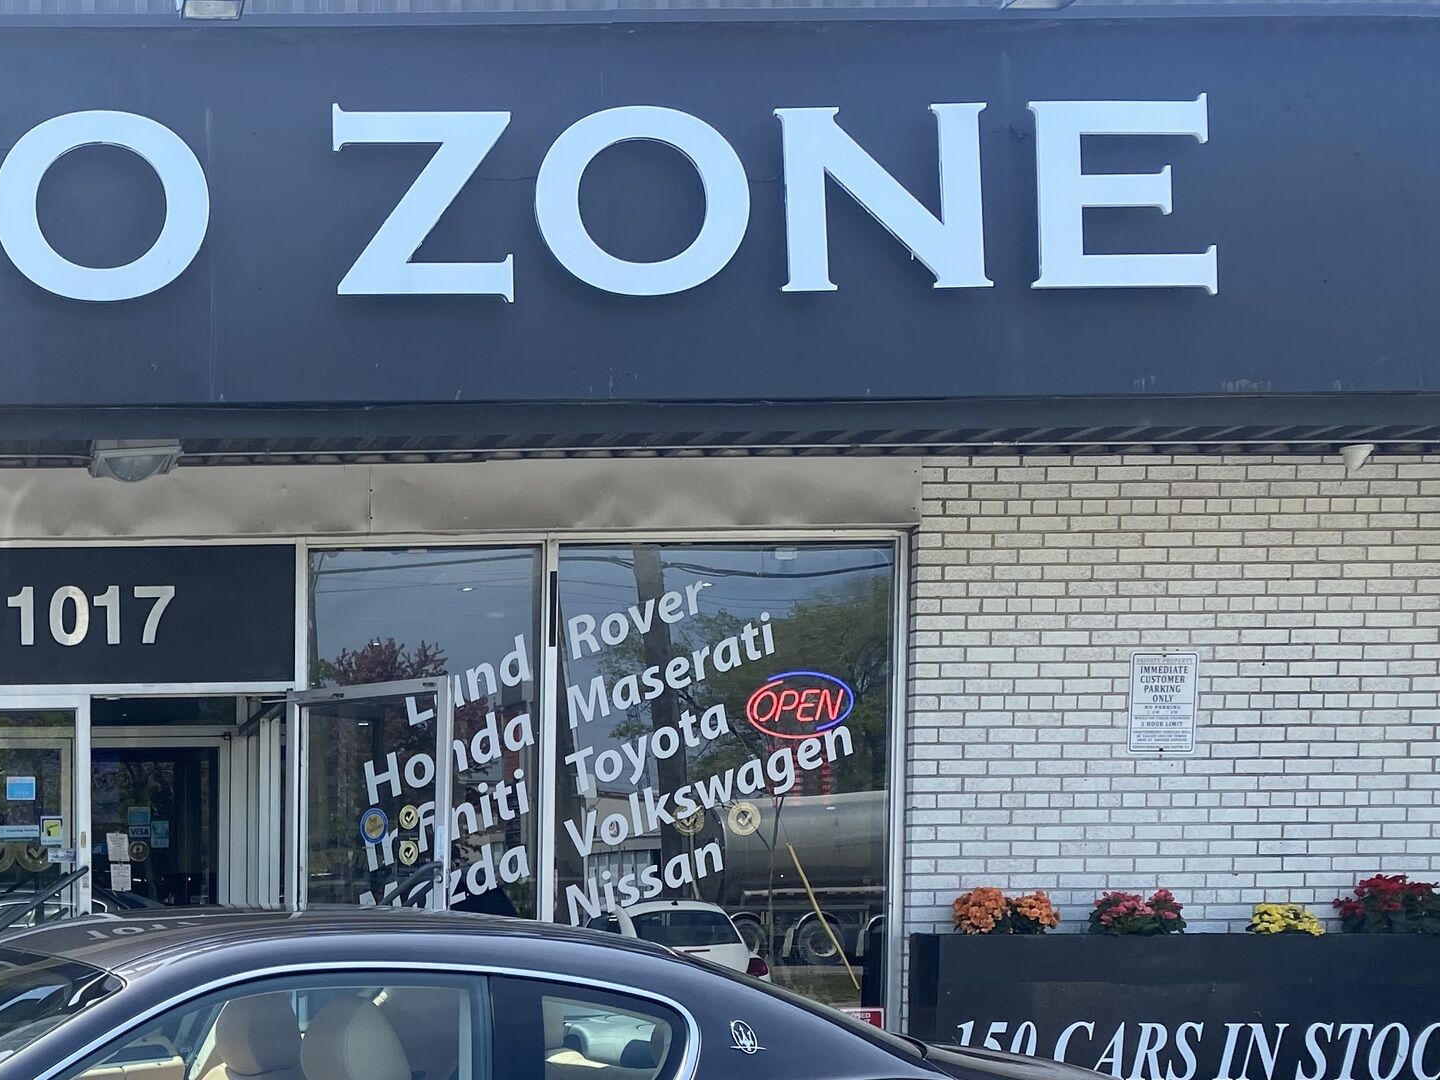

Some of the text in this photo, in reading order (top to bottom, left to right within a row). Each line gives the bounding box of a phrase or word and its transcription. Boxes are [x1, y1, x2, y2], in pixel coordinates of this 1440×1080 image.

[332, 93, 1218, 304] ZONE
[6, 584, 176, 647] 1017
[567, 580, 703, 661] Rover
[567, 612, 777, 730] Maserati
[753, 688, 844, 722] OPEN
[1140, 665, 1188, 674] IMMEDIATE
[1140, 675, 1185, 683] CUSTOMER
[1144, 685, 1181, 693] PARKING
[1152, 694, 1174, 702] ONLY
[564, 703, 730, 797] Toyota
[364, 769, 530, 872] Infniti
[564, 724, 854, 858] Volkswagen
[130, 828, 149, 836] VISA
[565, 841, 725, 928] Nissan
